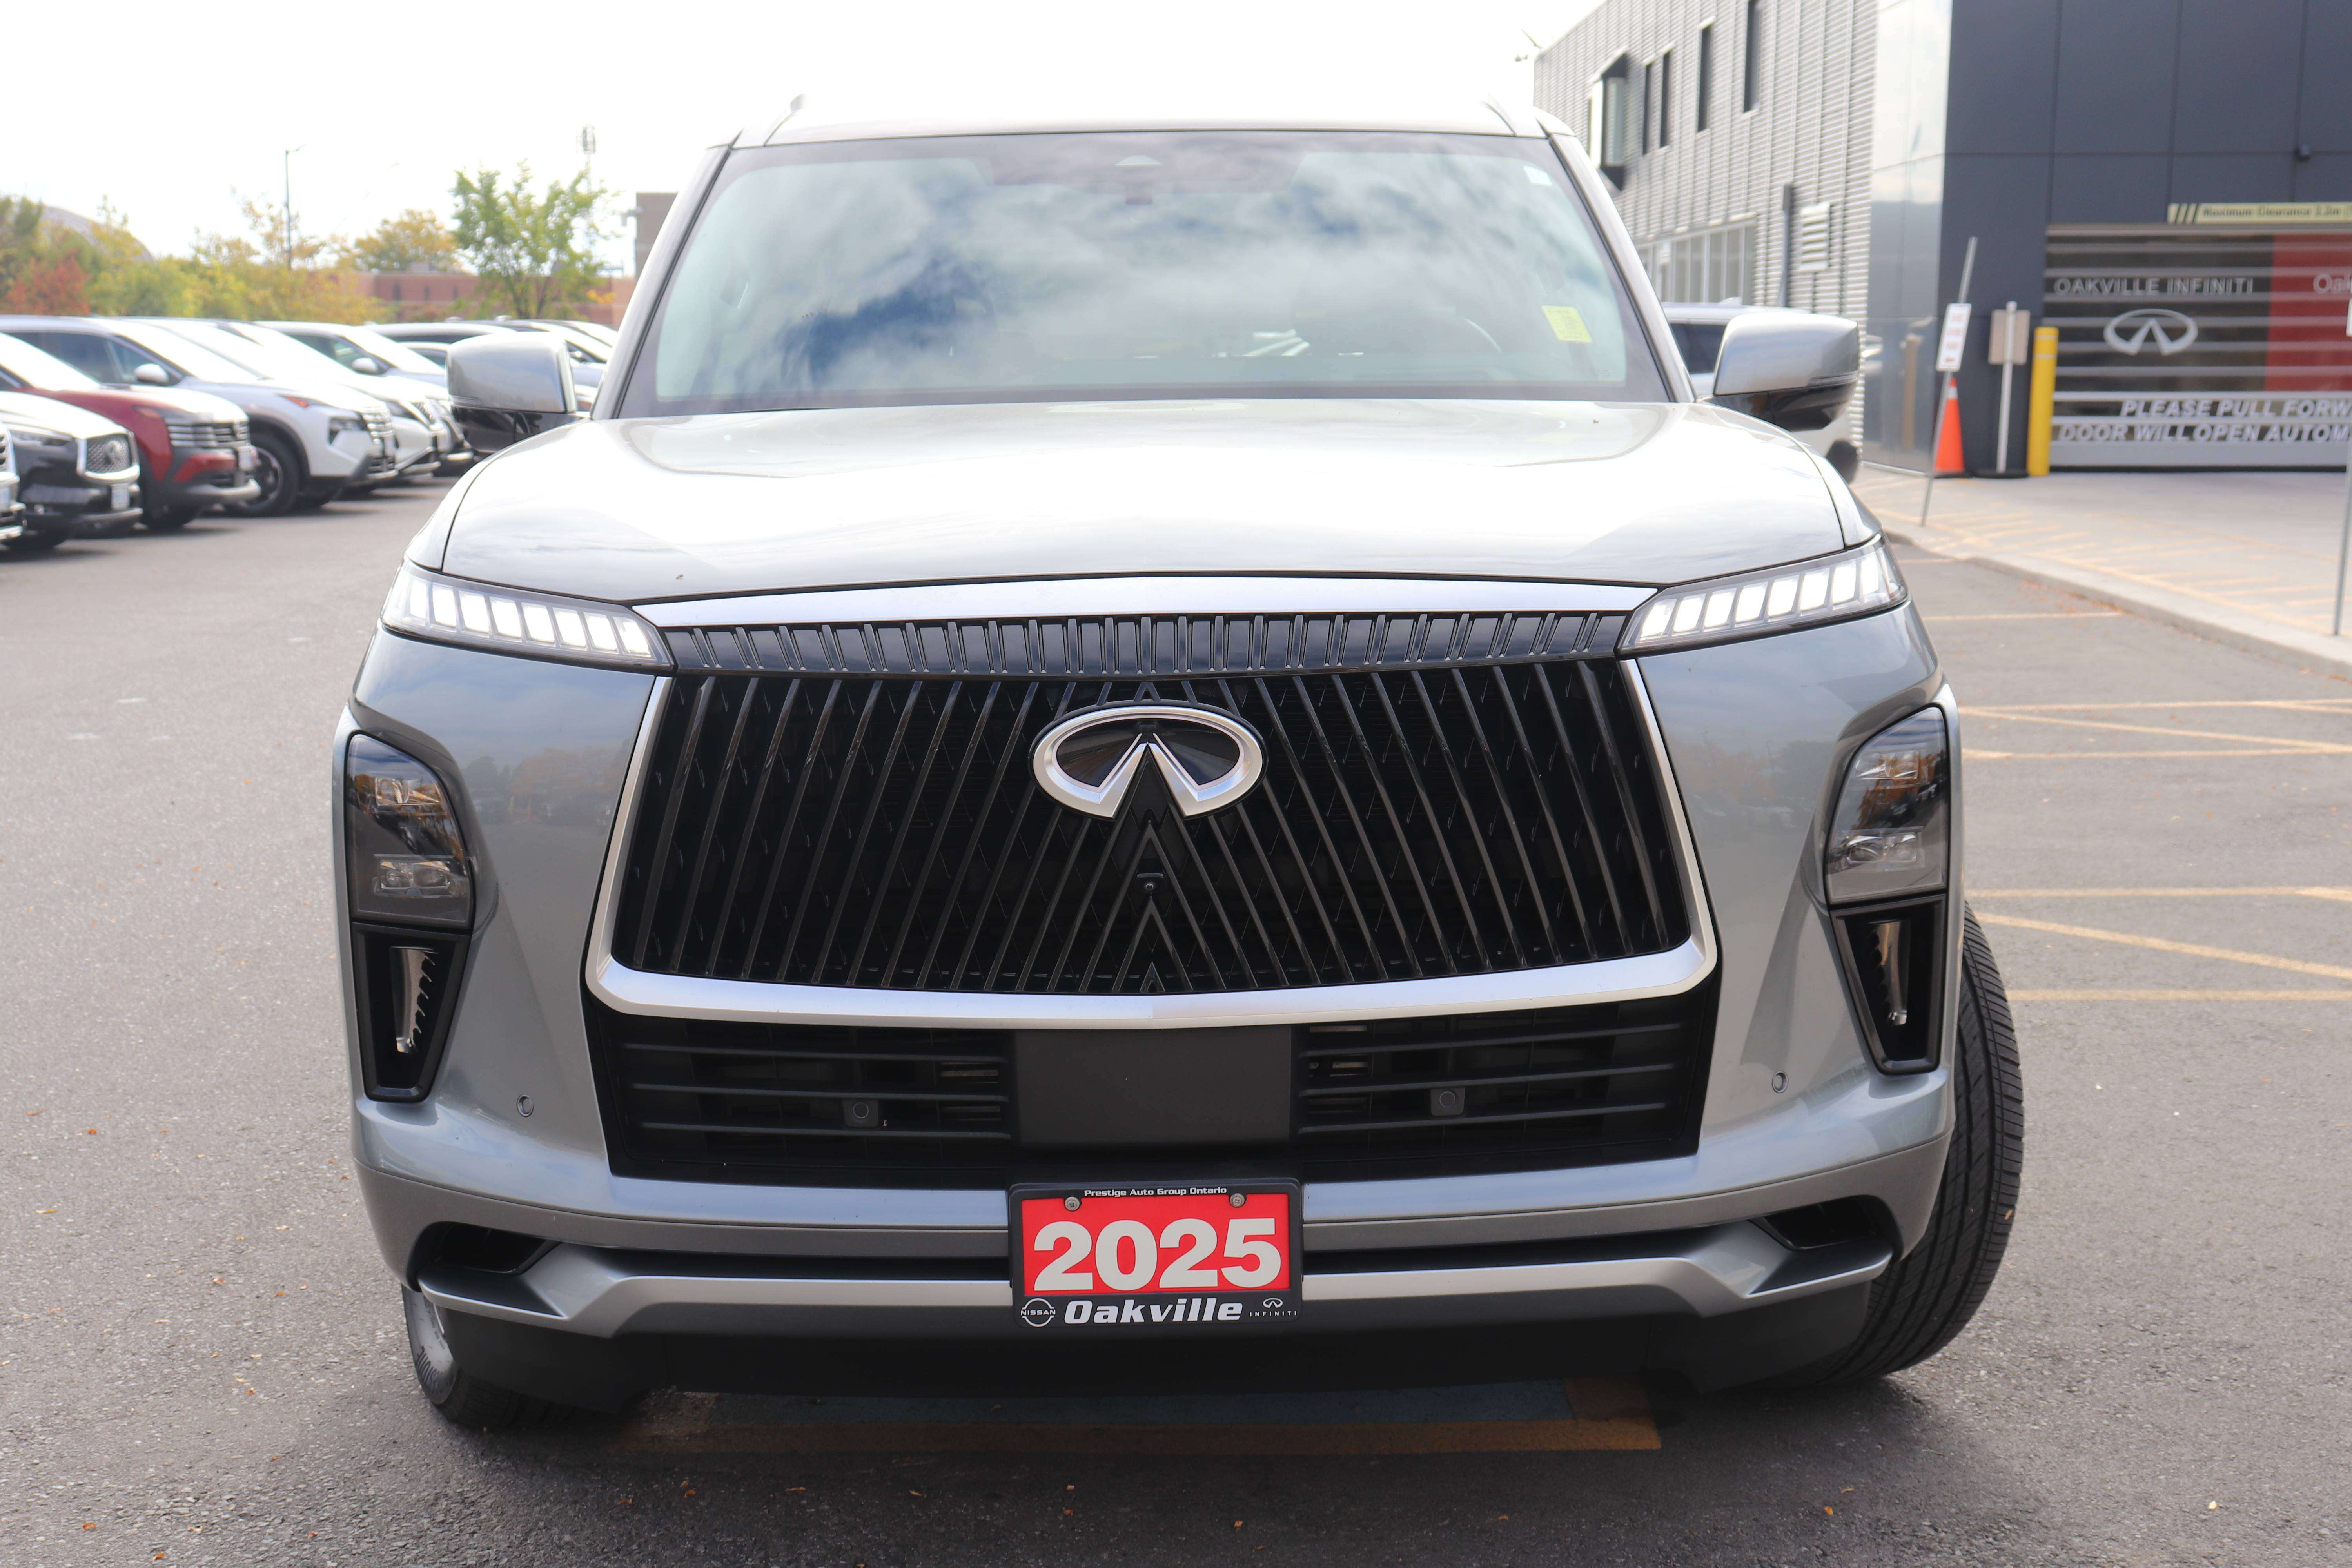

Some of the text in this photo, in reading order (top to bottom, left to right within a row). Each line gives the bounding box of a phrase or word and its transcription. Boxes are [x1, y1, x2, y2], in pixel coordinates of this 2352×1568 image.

[2203, 207, 2252, 216] Maximum
[2258, 206, 2310, 216] Clearance
[2054, 277, 2253, 296] OAKVILLE INFINITI
[2120, 399, 2352, 418] PLEASE PULL FORW
[2059, 423, 2352, 442] DOOR WILL OPEN AUTOM
[1084, 1189, 1127, 1197] Prestige
[1034, 1218, 1281, 1291] 2025
[1064, 1298, 1243, 1324] Oakville
